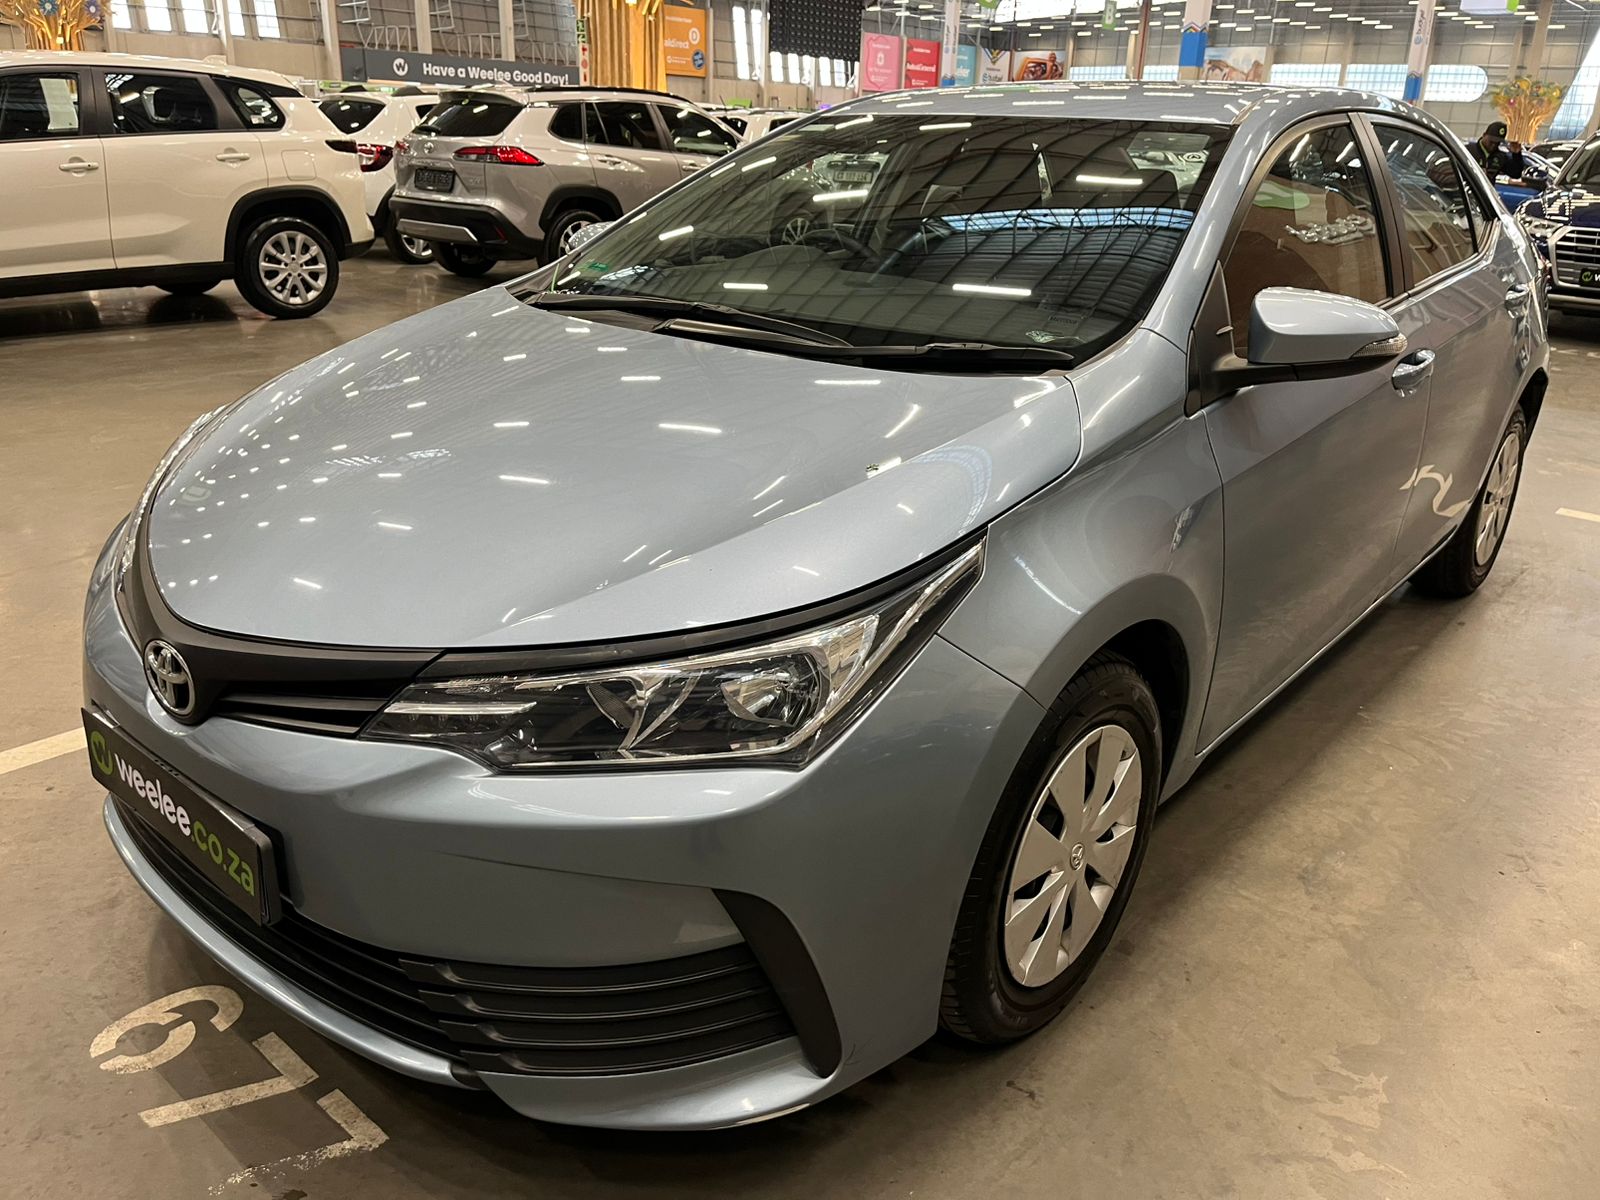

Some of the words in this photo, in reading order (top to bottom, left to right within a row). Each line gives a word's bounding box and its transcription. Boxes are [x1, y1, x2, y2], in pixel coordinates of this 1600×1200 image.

[423, 62, 455, 77] Have
[457, 68, 466, 78] a
[467, 66, 512, 82] Weelee
[512, 70, 542, 83] Good
[543, 72, 569, 86] Day!
